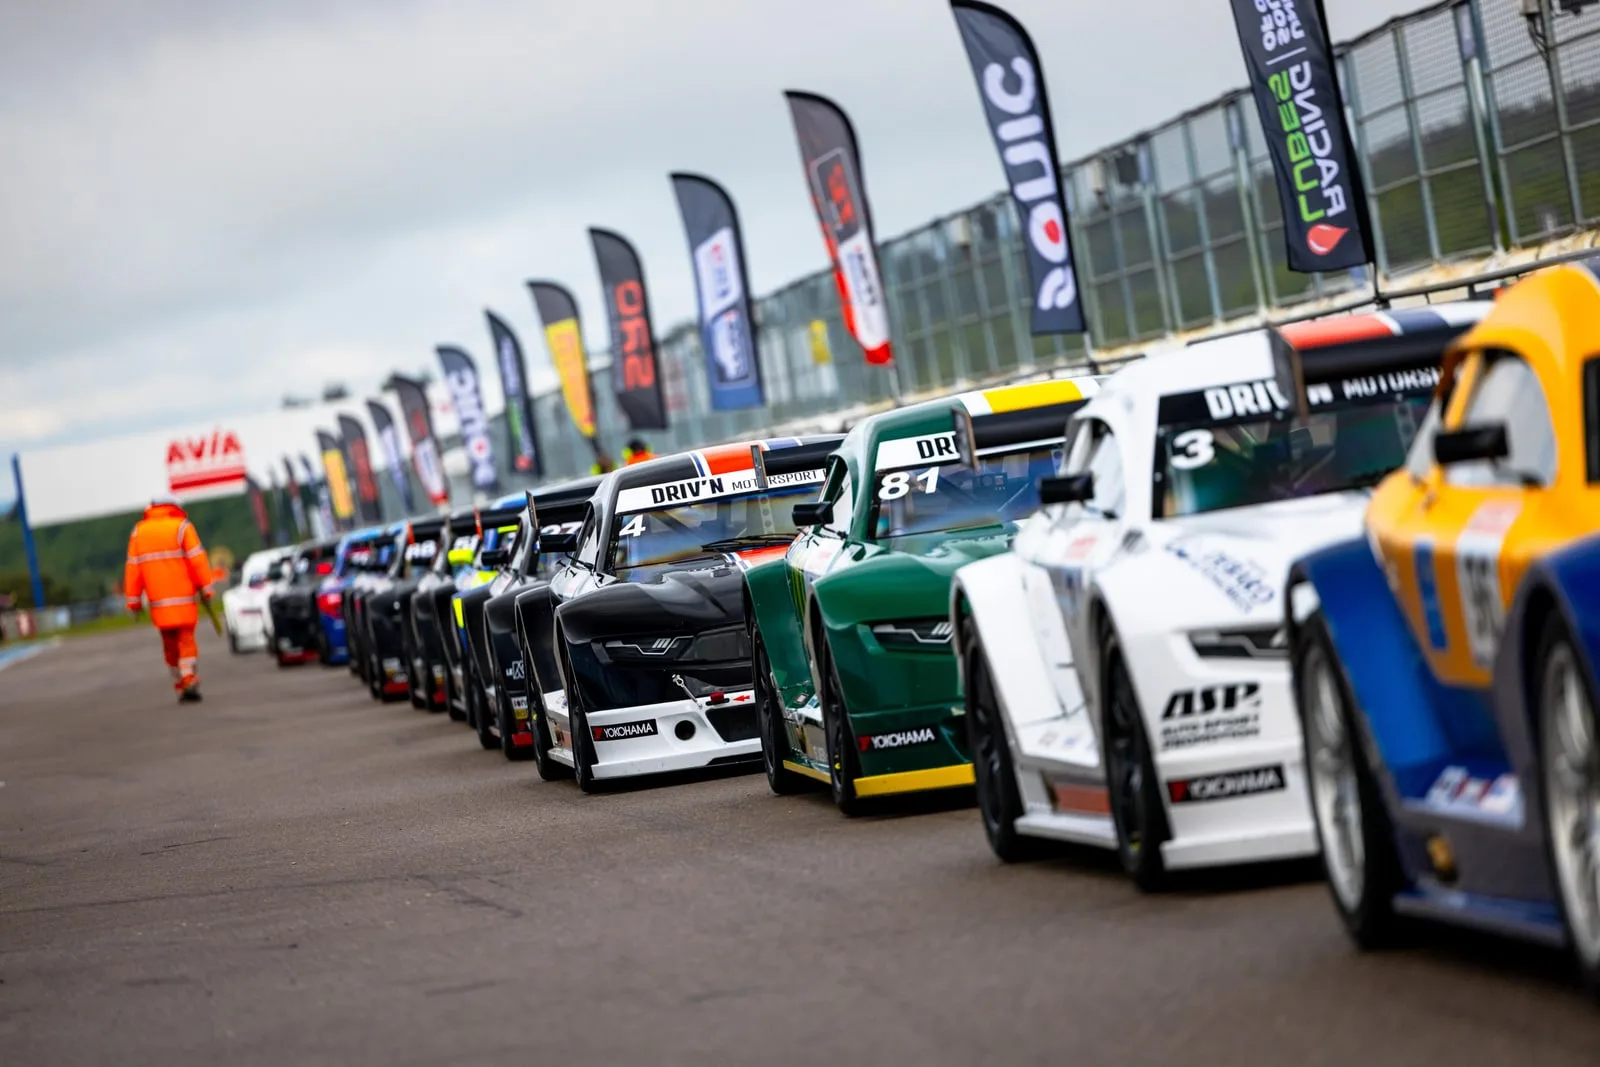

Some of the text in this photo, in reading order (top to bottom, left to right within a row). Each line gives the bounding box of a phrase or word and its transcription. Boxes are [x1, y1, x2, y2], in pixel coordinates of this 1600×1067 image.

[1170, 429, 1216, 470] 3
[651, 478, 724, 504] DRIV'N
[732, 469, 818, 491] MOTRSPORT
[878, 466, 940, 500] 81
[619, 514, 646, 537] 4
[604, 722, 654, 738] YOKOHAMA
[871, 728, 935, 749] YOKOHAMA
